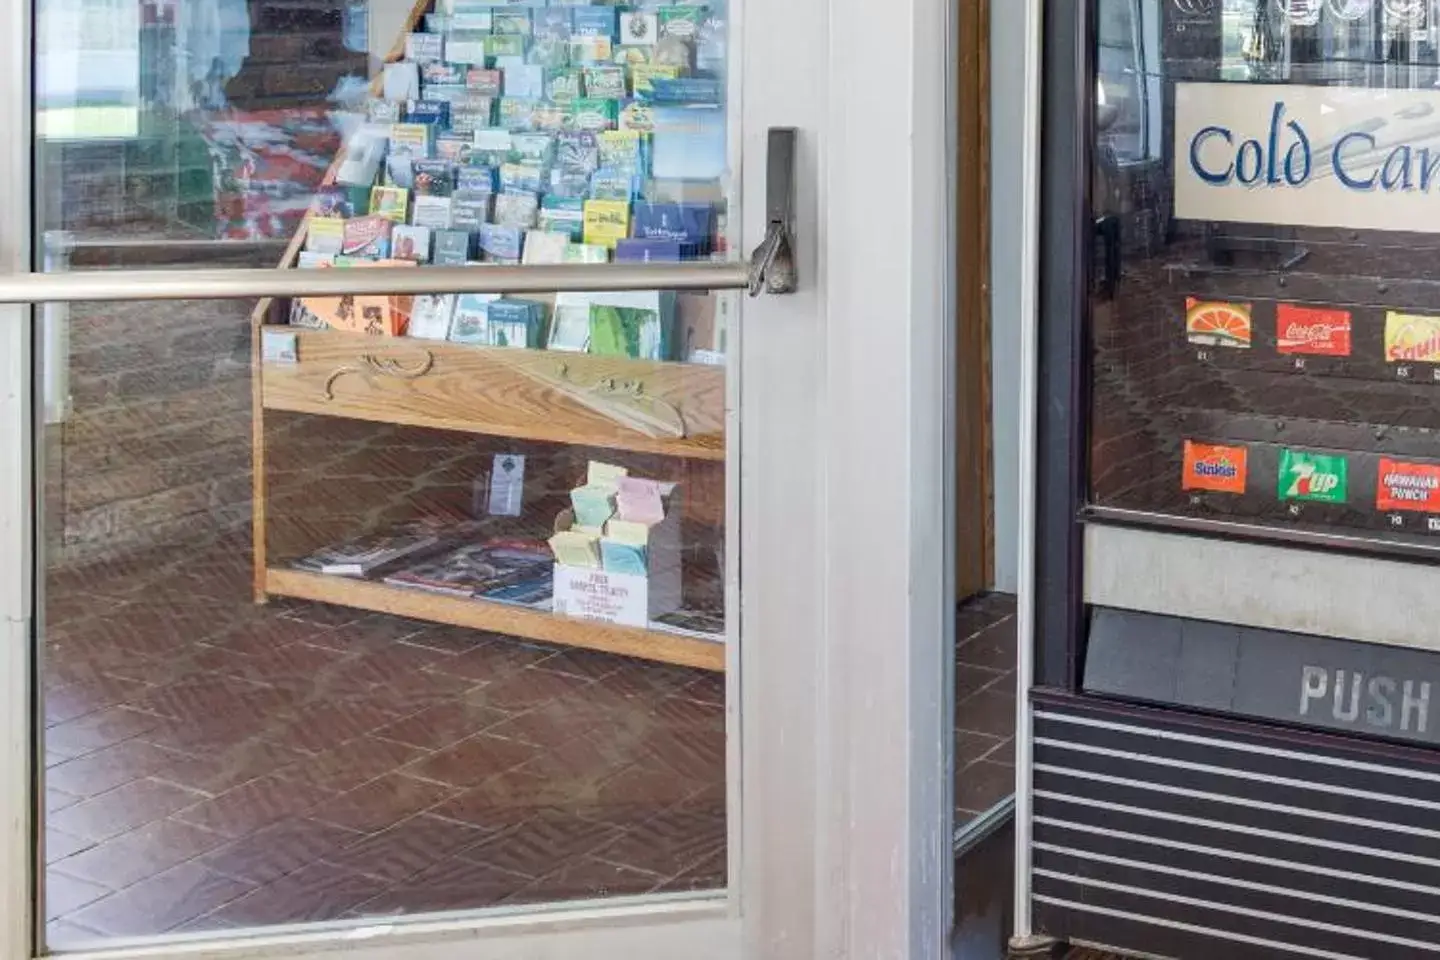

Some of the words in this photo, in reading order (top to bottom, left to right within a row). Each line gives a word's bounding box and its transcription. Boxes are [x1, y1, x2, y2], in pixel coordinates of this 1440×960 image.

[1189, 101, 1311, 189] Cold
[1286, 321, 1331, 342] Coca-Cola
[1194, 461, 1236, 477] Sunkist
[1384, 474, 1440, 489] HAWAIIAN
[1390, 487, 1428, 501] PUNCH
[1299, 664, 1432, 733] PUSH
